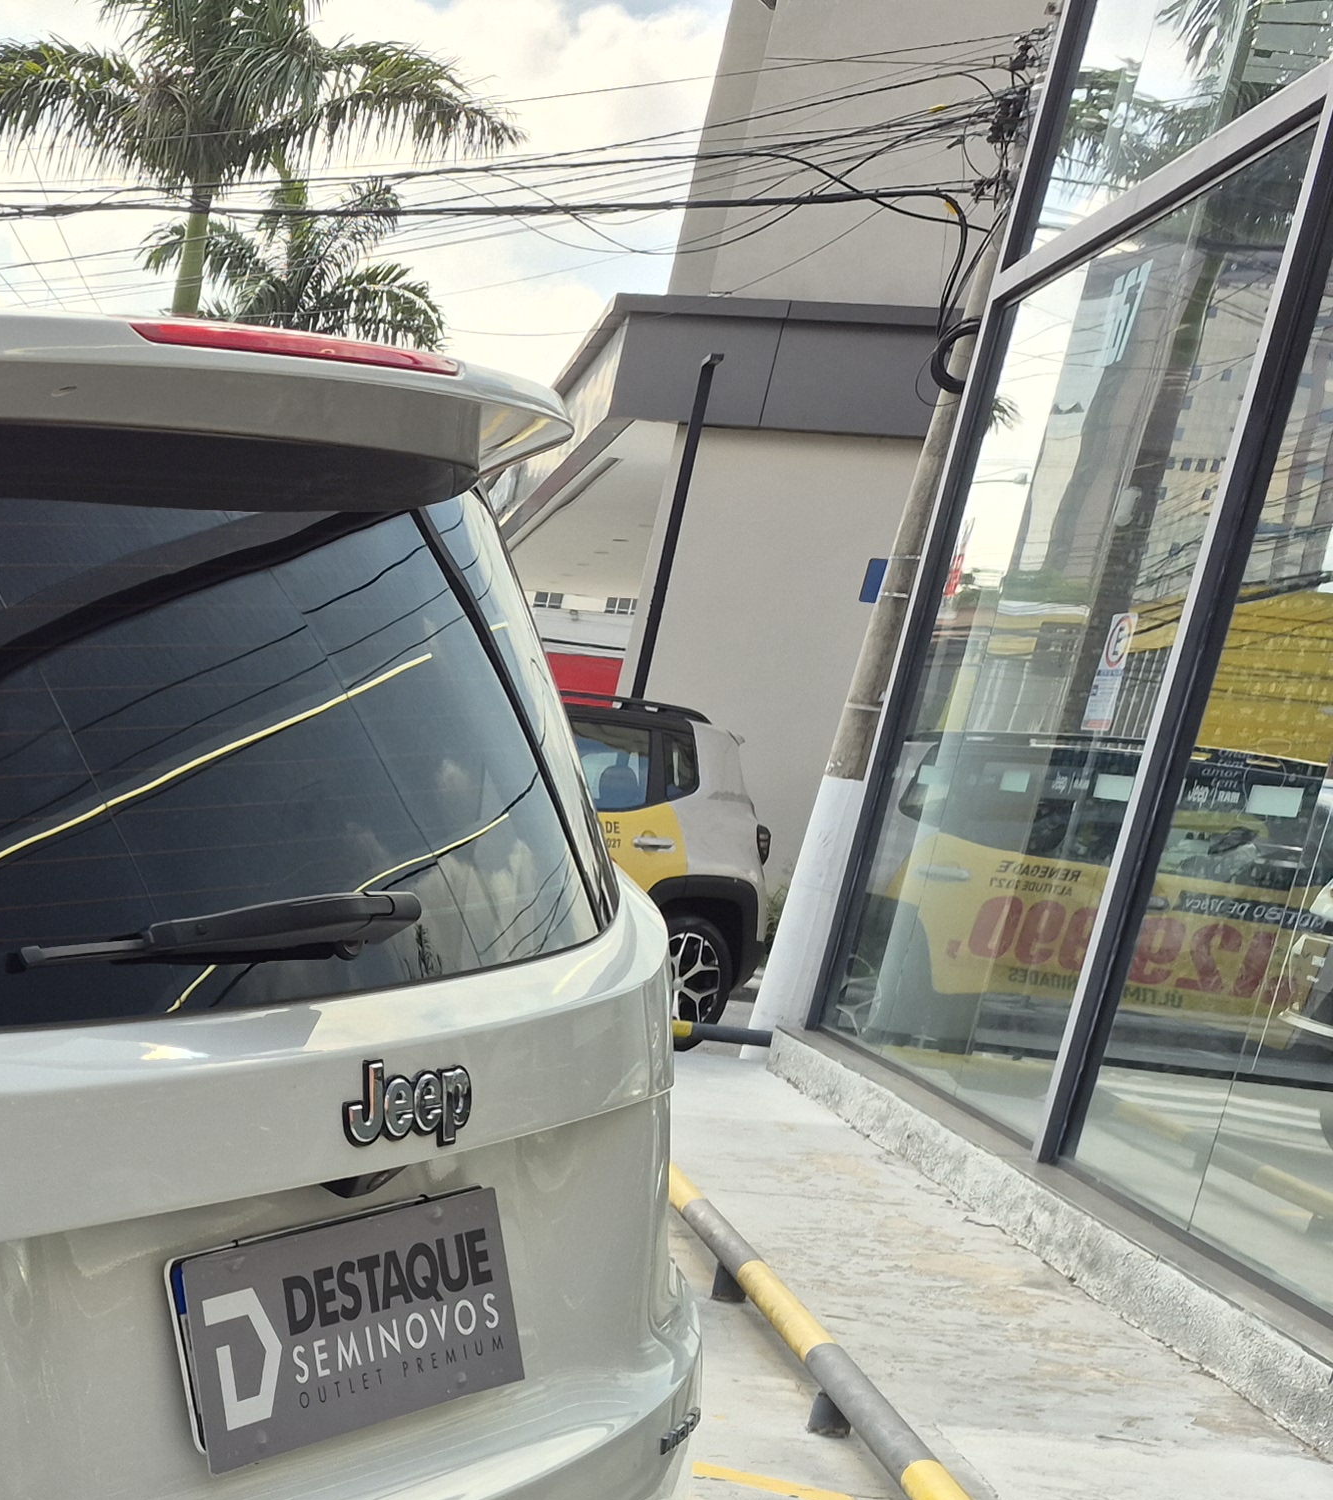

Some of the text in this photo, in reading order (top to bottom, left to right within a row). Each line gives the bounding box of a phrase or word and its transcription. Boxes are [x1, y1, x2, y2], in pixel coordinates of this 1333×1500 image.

[1217, 790, 1240, 804] RAM
[342, 1058, 473, 1148] Jeep
[282, 1228, 493, 1337] DESTAQUE
[292, 1292, 499, 1384] SEMINOVOS
[298, 1335, 505, 1409] OUTLET PREMIUM
